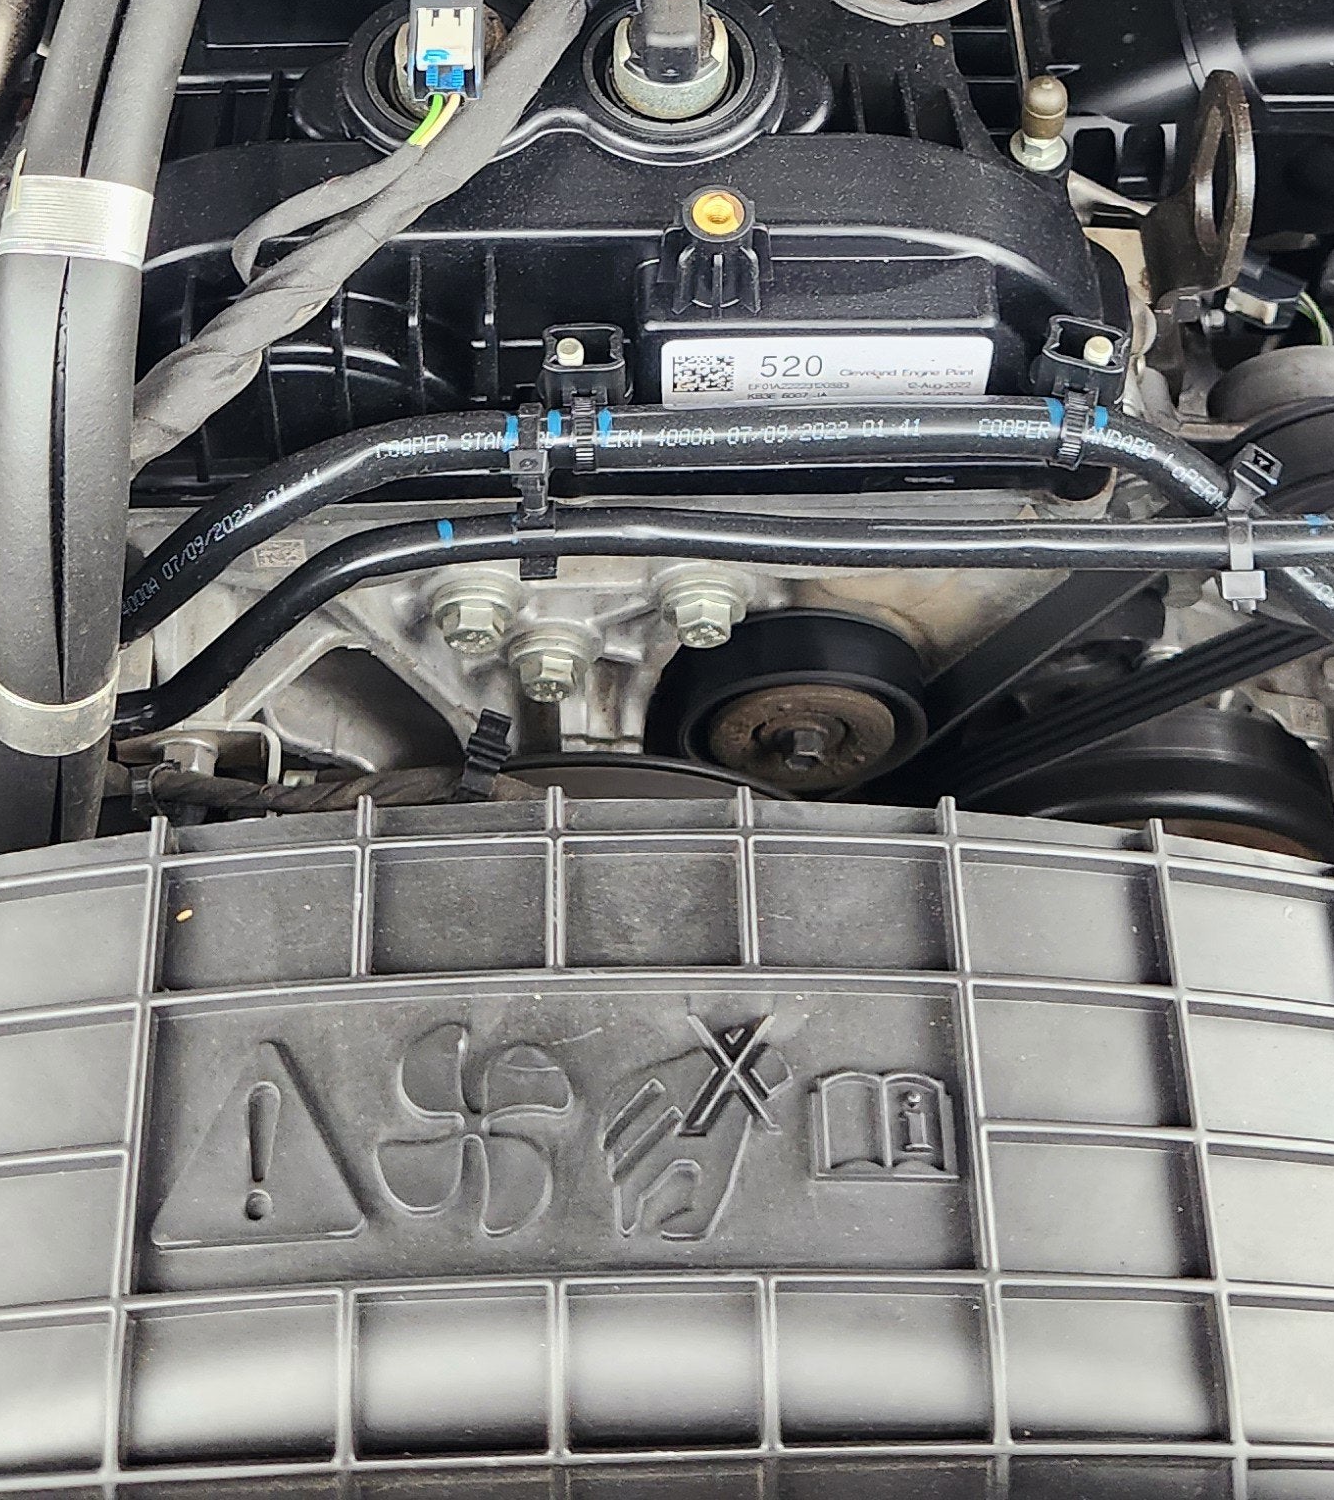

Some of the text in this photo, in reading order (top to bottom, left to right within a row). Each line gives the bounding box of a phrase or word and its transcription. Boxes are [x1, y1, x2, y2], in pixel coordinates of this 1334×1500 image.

[760, 355, 824, 378] 520
[839, 367, 975, 378] Cleveland Engine Plant
[375, 433, 448, 458] COOPER
[655, 427, 715, 448] 4000A
[726, 421, 849, 447] 07/09/2022
[978, 417, 1051, 440] COOPER
